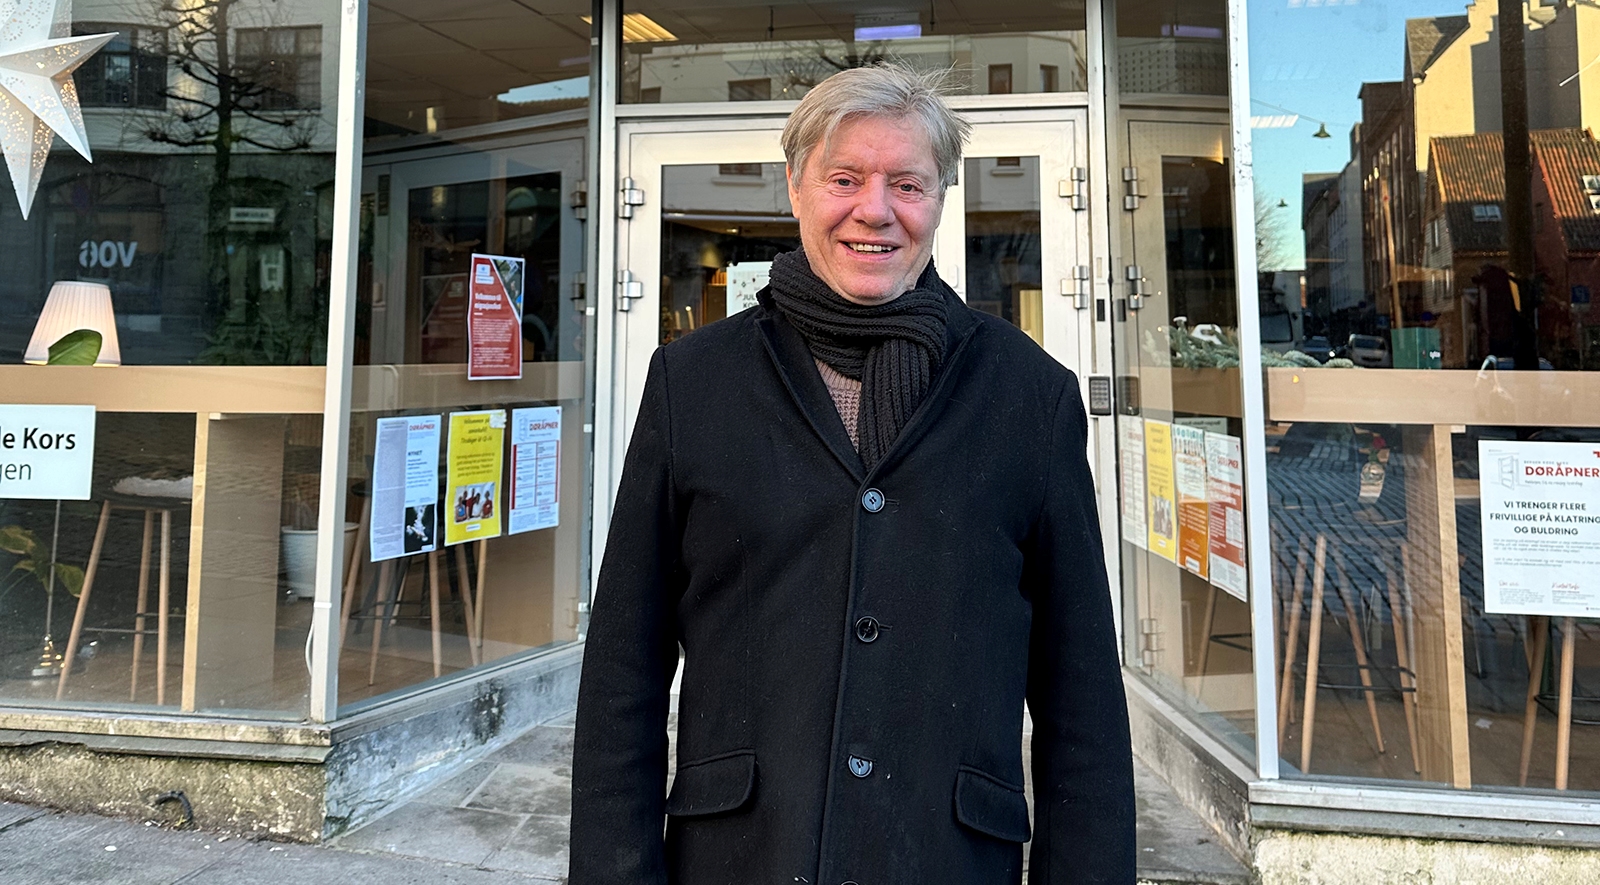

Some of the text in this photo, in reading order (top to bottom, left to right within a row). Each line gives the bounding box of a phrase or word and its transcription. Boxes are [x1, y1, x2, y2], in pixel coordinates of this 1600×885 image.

[0, 426, 76, 450] e Kors
[1525, 463, 1600, 478] DØRÅPNER
[1516, 501, 1558, 510] TRENGER
[1560, 502, 1587, 511] FLERE
[1490, 513, 1538, 522] FRIVILLIGE
[1539, 512, 1553, 522] PÅ
[1514, 526, 1579, 535] OG BULDRING
